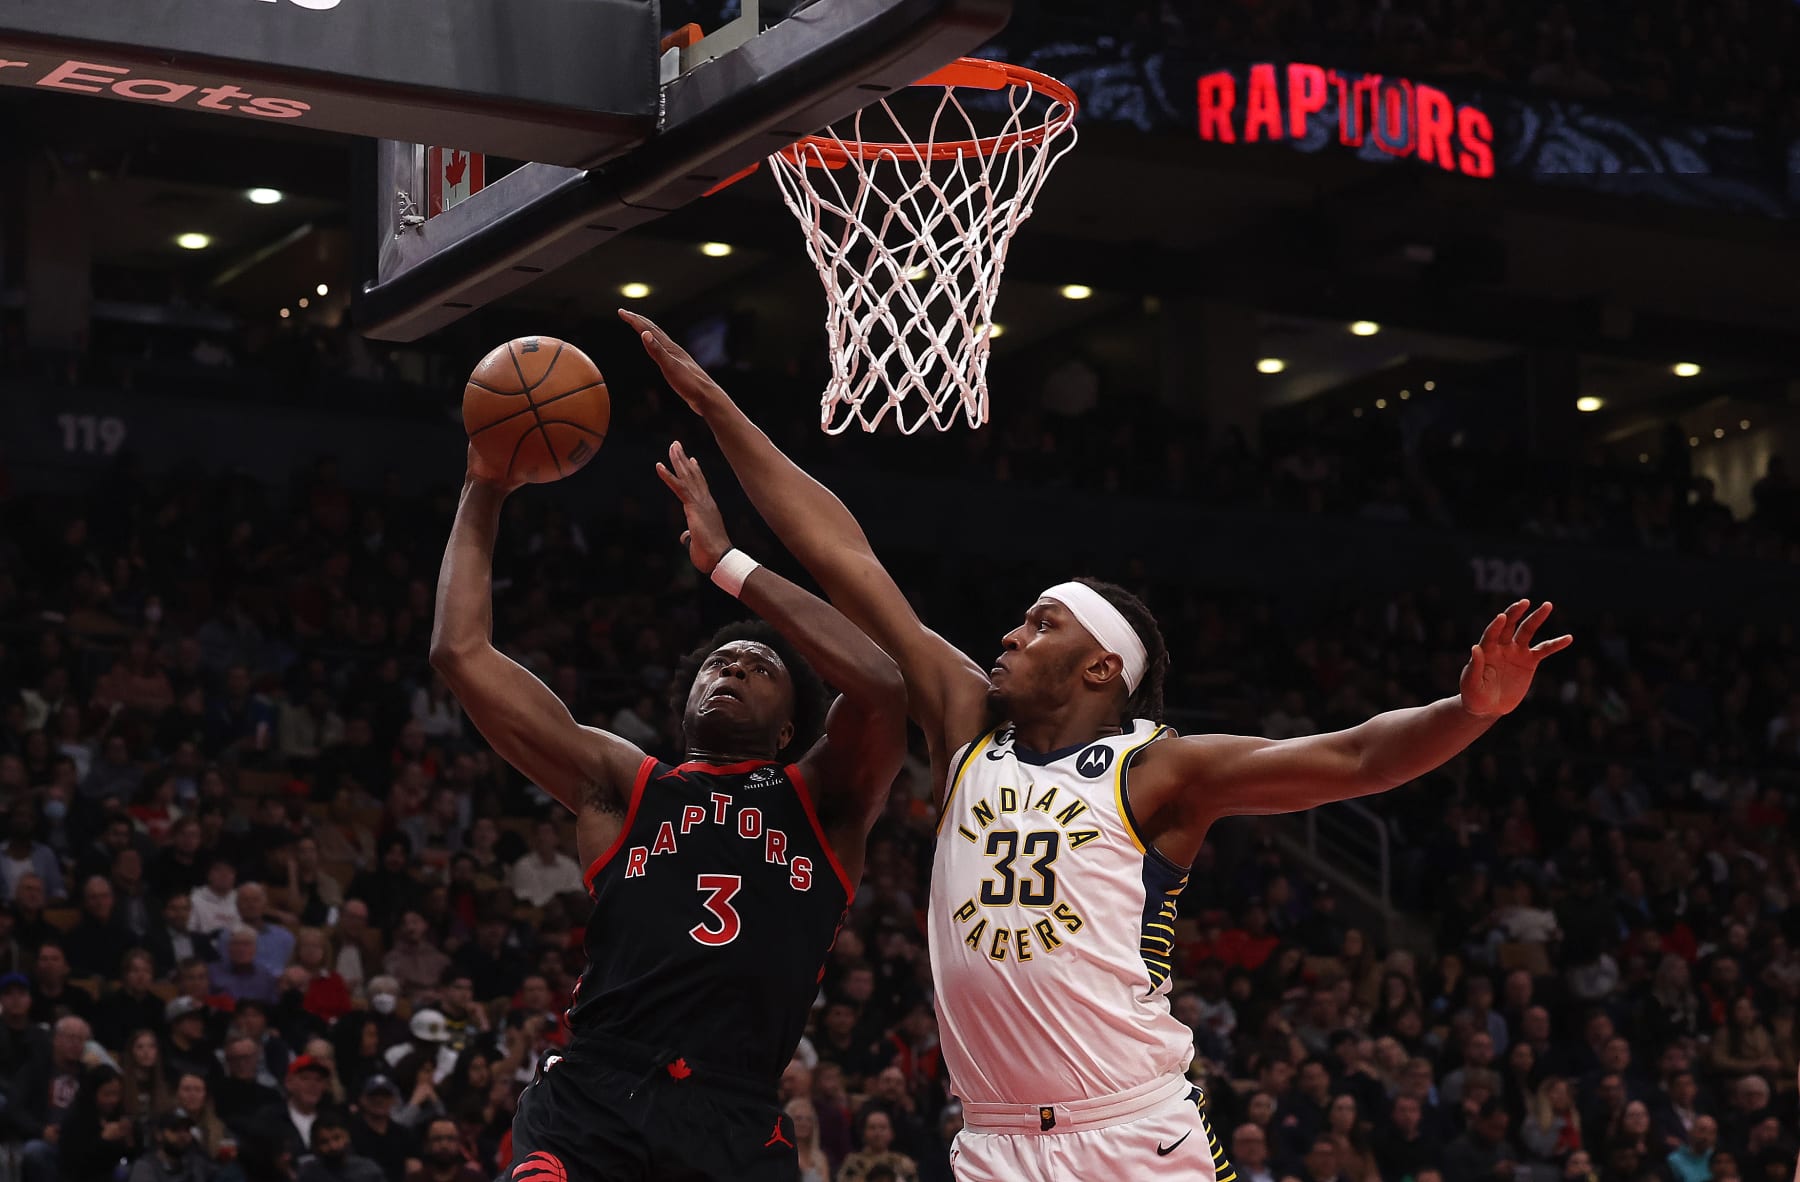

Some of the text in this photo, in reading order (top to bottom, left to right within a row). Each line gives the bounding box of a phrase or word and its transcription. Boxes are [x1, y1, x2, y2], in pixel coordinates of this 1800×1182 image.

[36, 60, 311, 118] Eats
[1197, 62, 1495, 178] RAPTORS
[58, 414, 126, 455] 119
[1470, 557, 1532, 594] 120
[625, 792, 812, 891] RAPTORS
[958, 784, 1101, 850] INDIANA
[979, 829, 1060, 908] 33
[689, 874, 742, 947] 3
[953, 899, 1085, 962] PACERS
